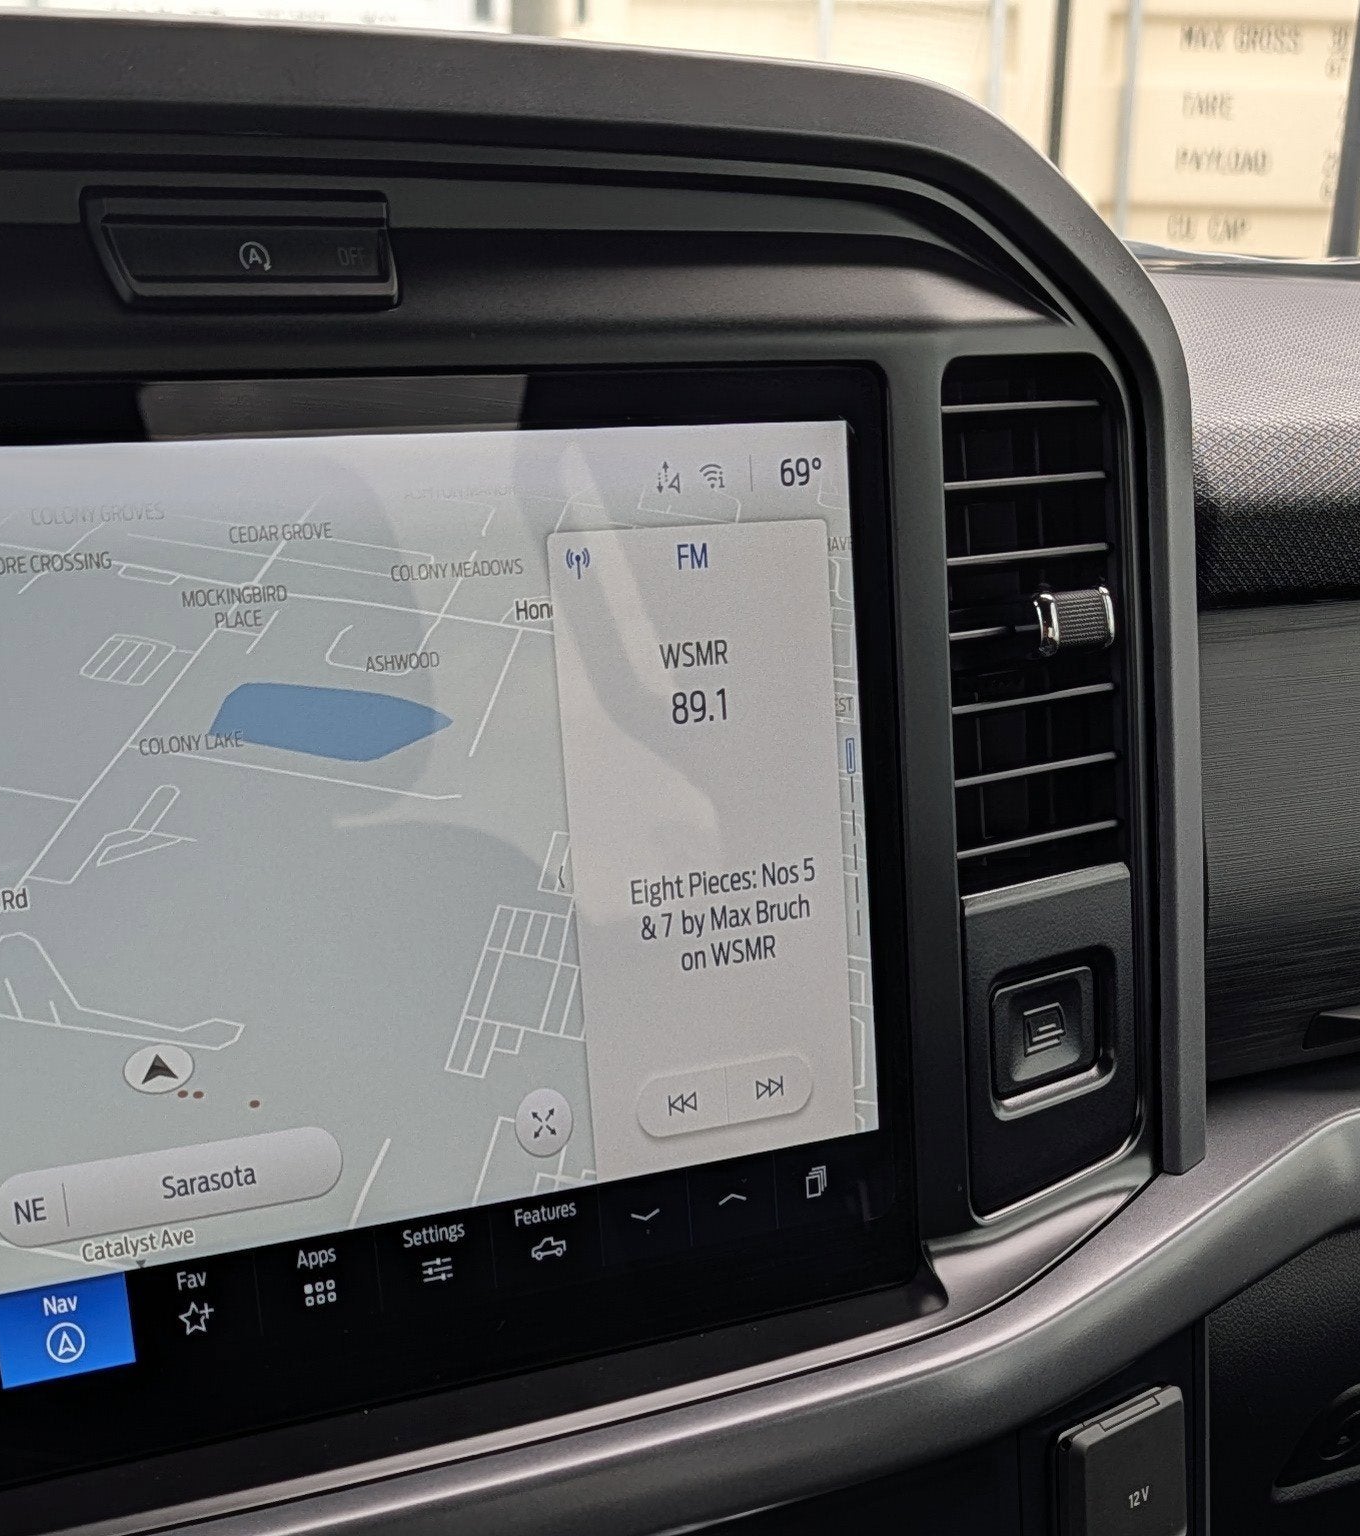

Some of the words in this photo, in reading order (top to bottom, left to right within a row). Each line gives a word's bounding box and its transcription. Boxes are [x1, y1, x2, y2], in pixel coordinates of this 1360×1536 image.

[779, 457, 822, 487] 69°
[228, 523, 280, 543] CEDAR
[282, 521, 332, 541] GROVE
[30, 551, 112, 575] CROSSING
[390, 562, 448, 583] COLONY
[451, 557, 523, 579] MEADOWS
[677, 545, 709, 569] FM
[181, 584, 288, 609] MOCKINGBIRD
[214, 609, 263, 630] PLACE
[515, 600, 553, 621] Hon
[365, 650, 440, 673] ASHWOOD
[660, 640, 729, 669] WSMR
[672, 689, 729, 726] 89.1
[139, 734, 201, 756] COLONY
[204, 731, 243, 750] LAKE
[630, 876, 684, 909] Eight
[688, 867, 758, 901] Pieces:
[762, 860, 799, 888] Nos
[803, 857, 816, 883] 5
[2, 888, 29, 913] Rd
[641, 914, 658, 941] &
[661, 912, 673, 938] 7
[681, 908, 706, 937] by
[710, 904, 752, 932] Max
[756, 894, 811, 925] Bruch
[680, 947, 707, 972] on
[711, 935, 777, 969] WSMR
[161, 1162, 257, 1201] Sarasota
[13, 1196, 47, 1226] NE
[514, 1201, 577, 1227] Features
[81, 1231, 154, 1263] Catalyst
[155, 1226, 195, 1252] Ave
[402, 1220, 466, 1249] Settings
[296, 1246, 337, 1272] Apps
[176, 1268, 207, 1290] Fav
[42, 1292, 78, 1316] Nav
